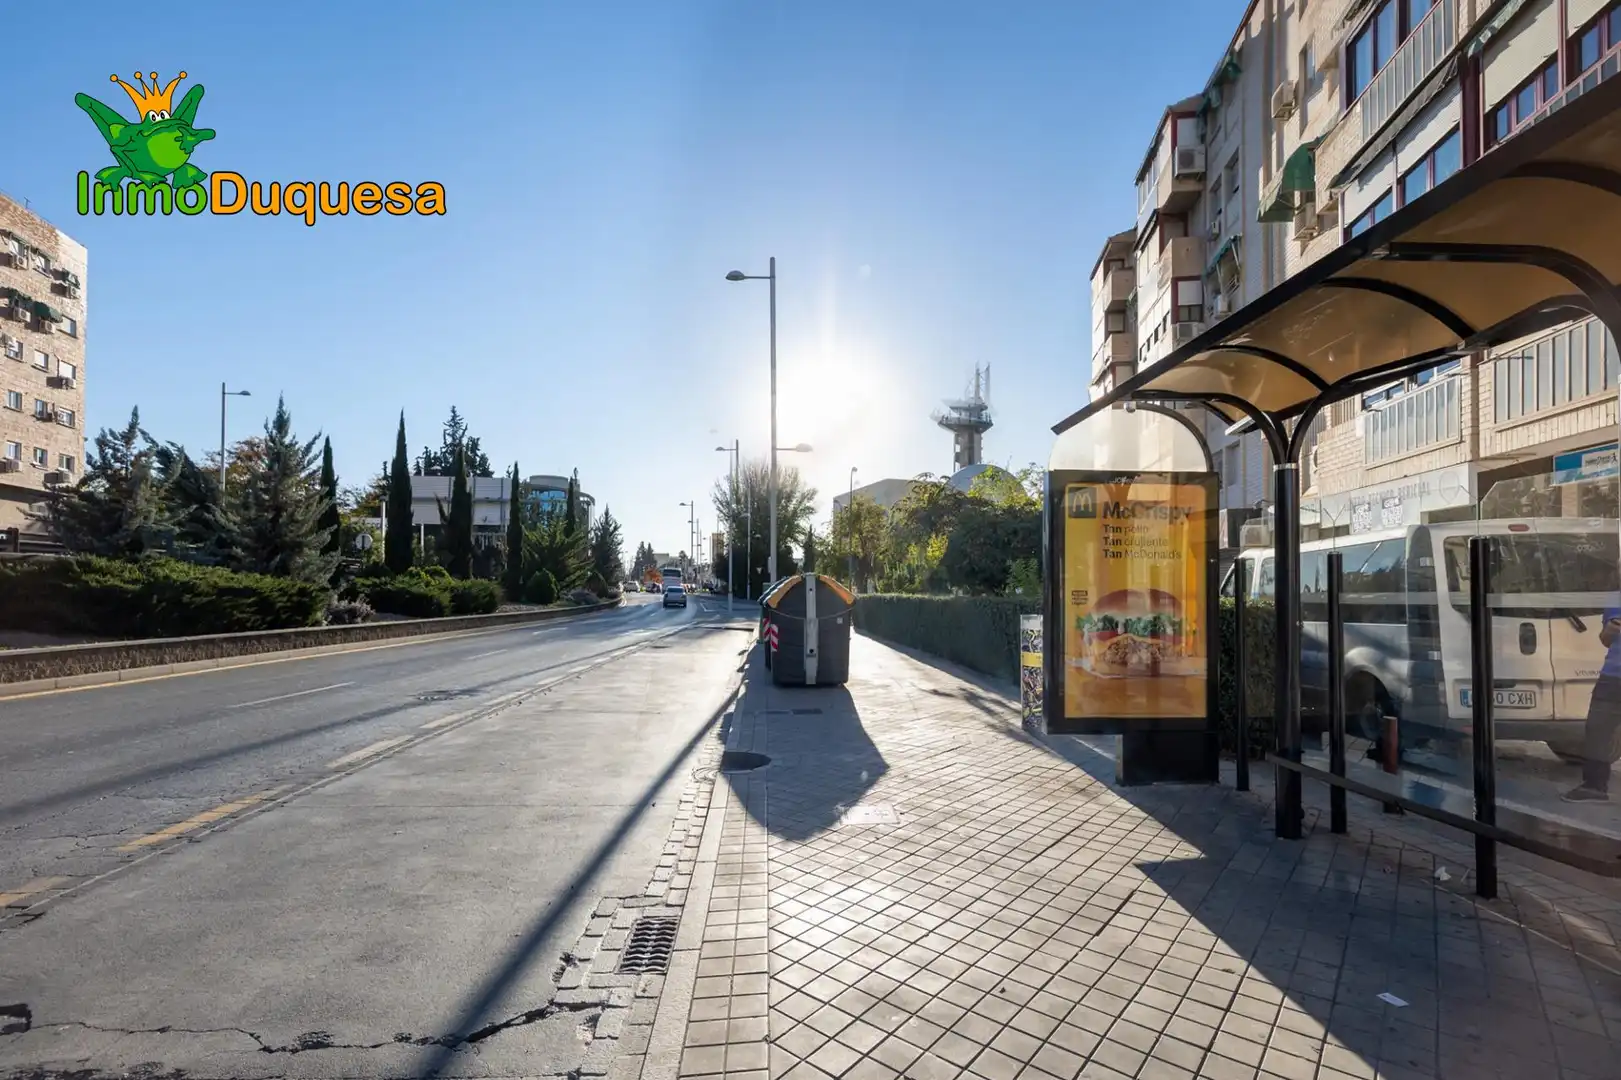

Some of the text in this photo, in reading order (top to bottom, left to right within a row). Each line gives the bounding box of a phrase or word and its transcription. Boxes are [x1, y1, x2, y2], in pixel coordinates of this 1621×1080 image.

[1102, 501, 1192, 525] McCrispy
[1103, 524, 1149, 536] Tan pollo
[1103, 536, 1168, 548] Tan crujiente
[1103, 549, 1182, 560] Tan McDonald's
[1508, 692, 1533, 705] CXH
